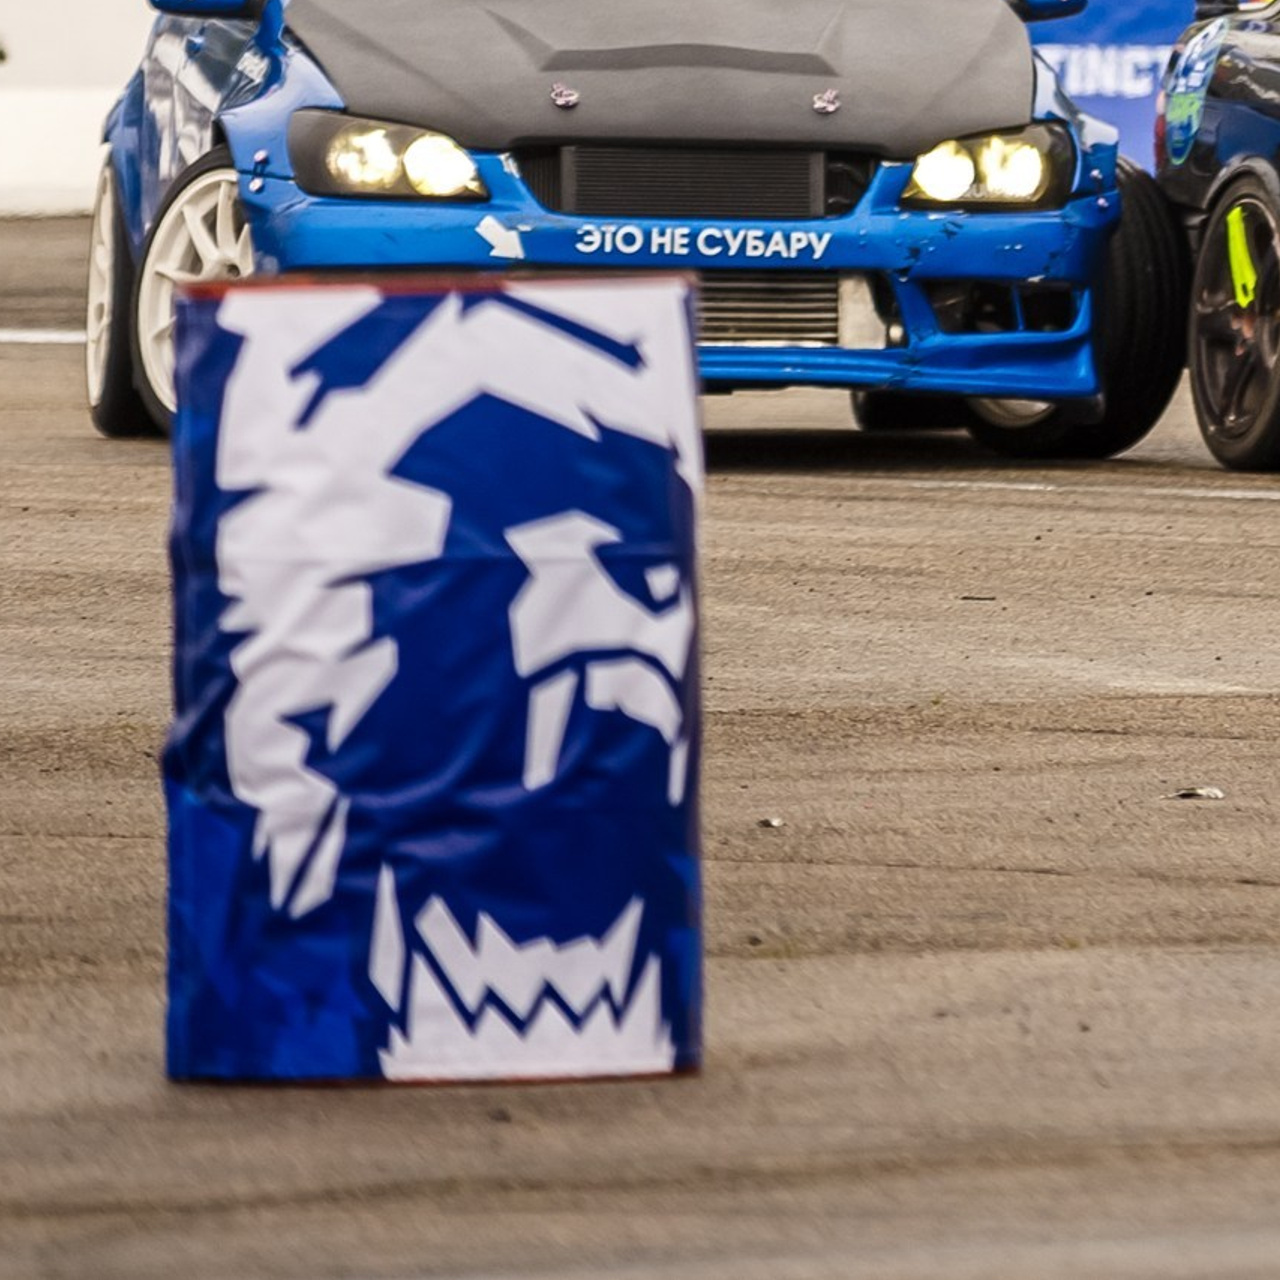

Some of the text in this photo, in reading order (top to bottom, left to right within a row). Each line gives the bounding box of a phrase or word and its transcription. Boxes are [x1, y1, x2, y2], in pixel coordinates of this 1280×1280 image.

[575, 223, 832, 261] ЭТО НЕ СУБАРУ
